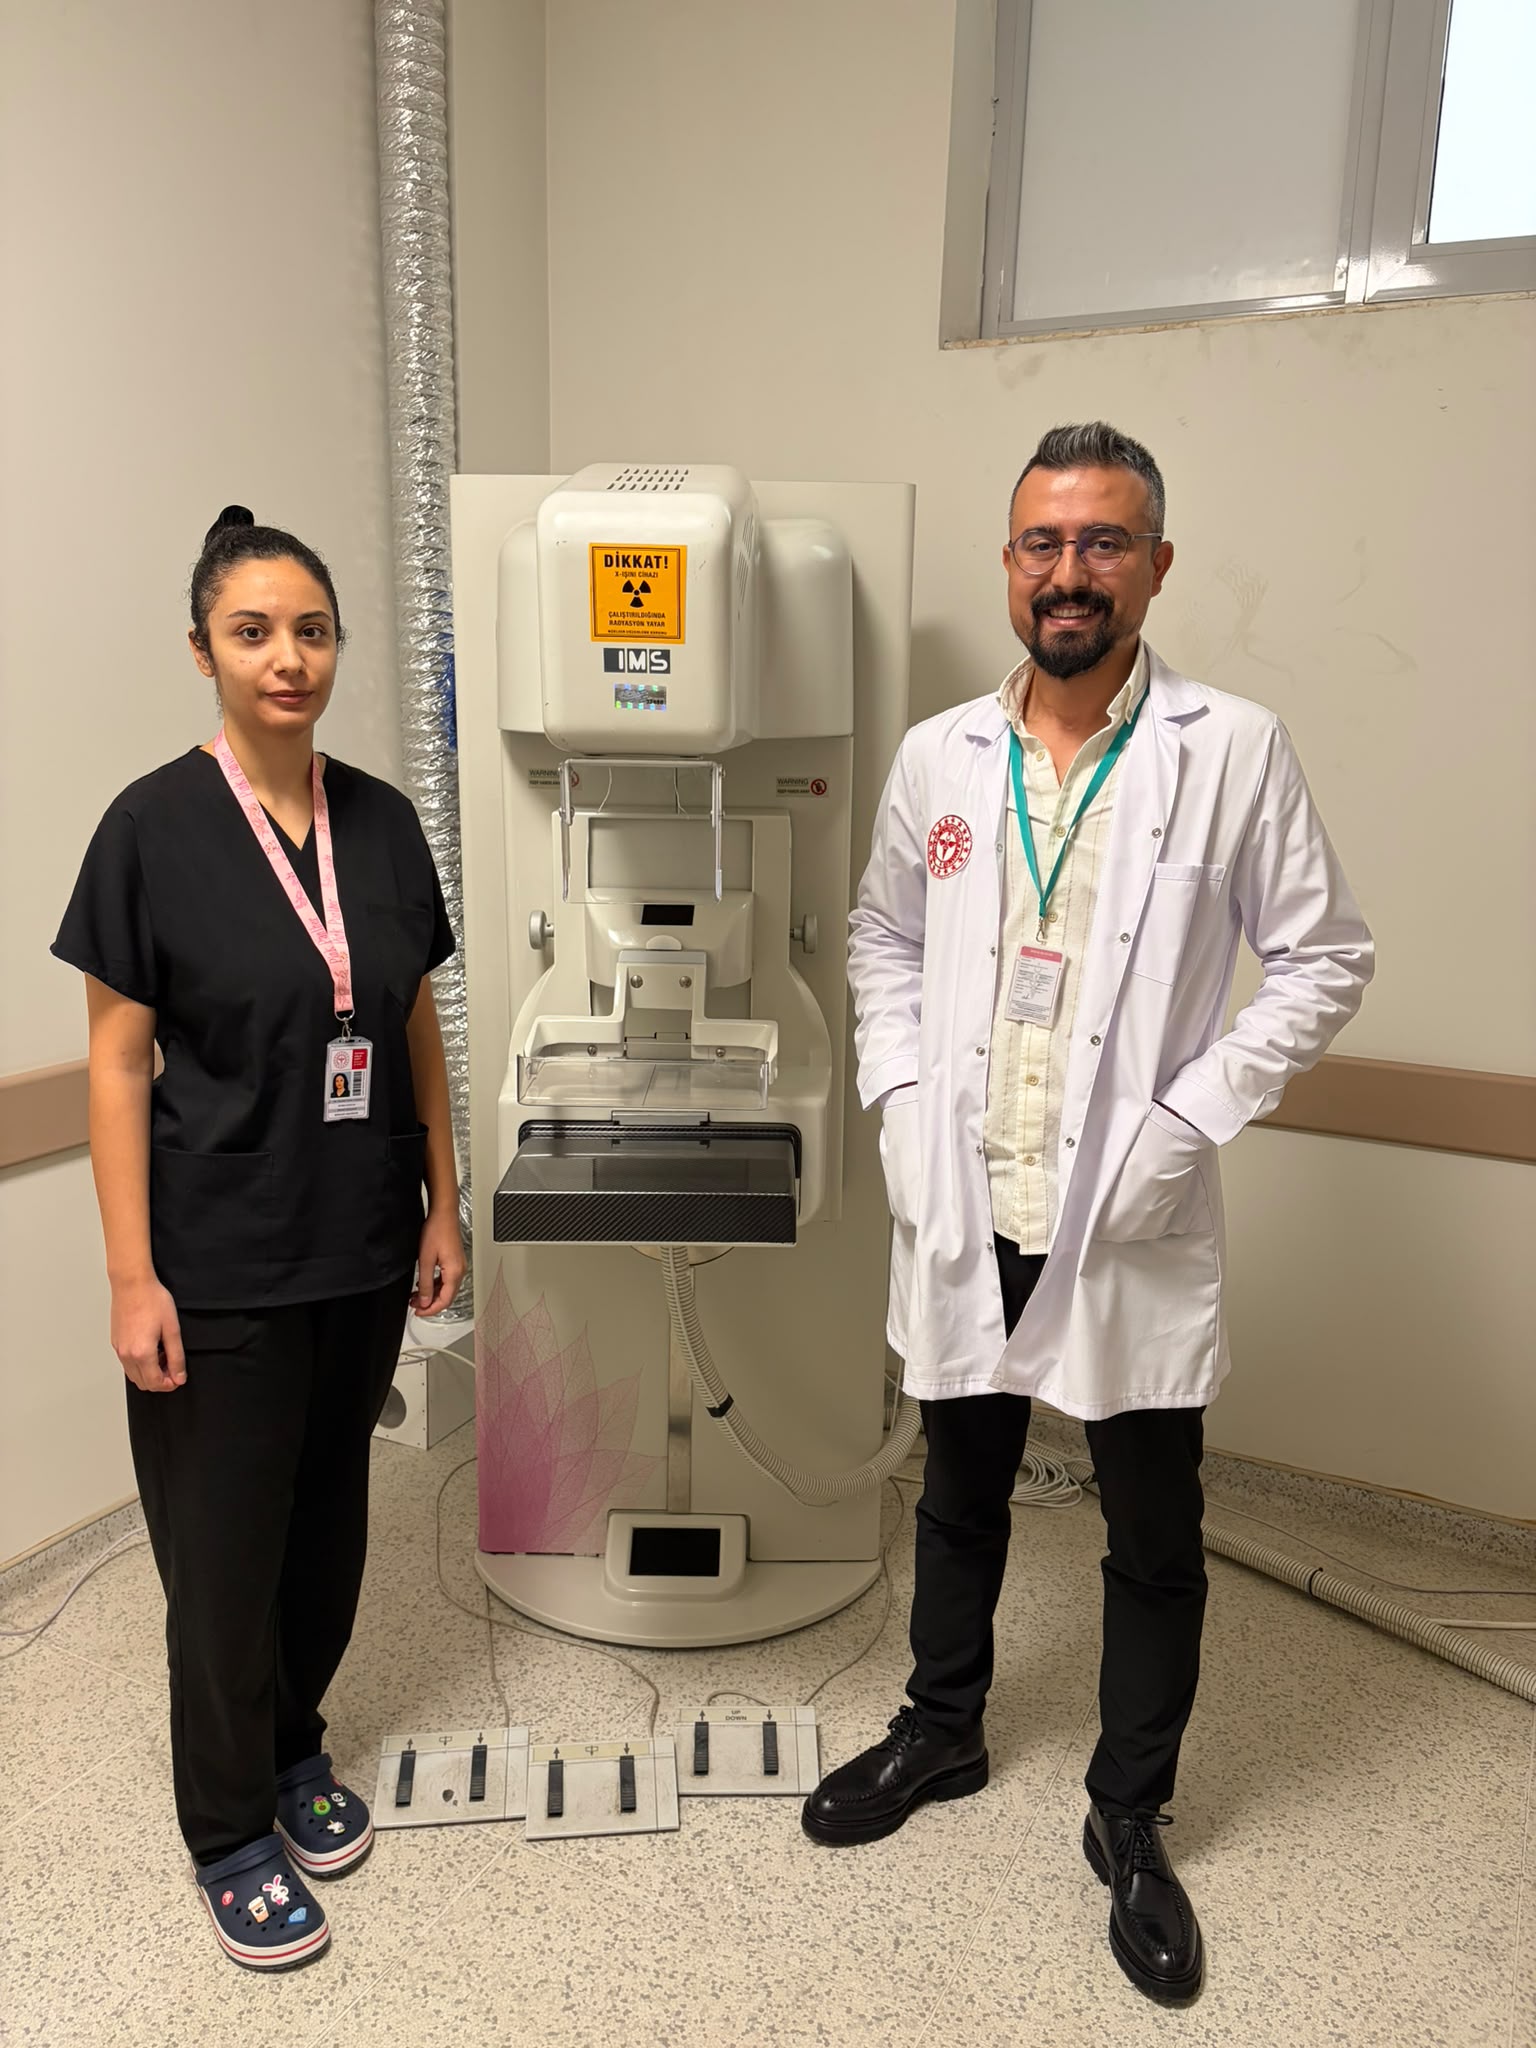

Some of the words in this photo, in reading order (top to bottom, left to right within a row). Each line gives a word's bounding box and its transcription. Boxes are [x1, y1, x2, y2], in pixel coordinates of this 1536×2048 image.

[604, 551, 668, 569] DİKKAT!
[608, 611, 666, 619] ÇALIŞTIRILDIĞINDA
[618, 650, 668, 671] IMS
